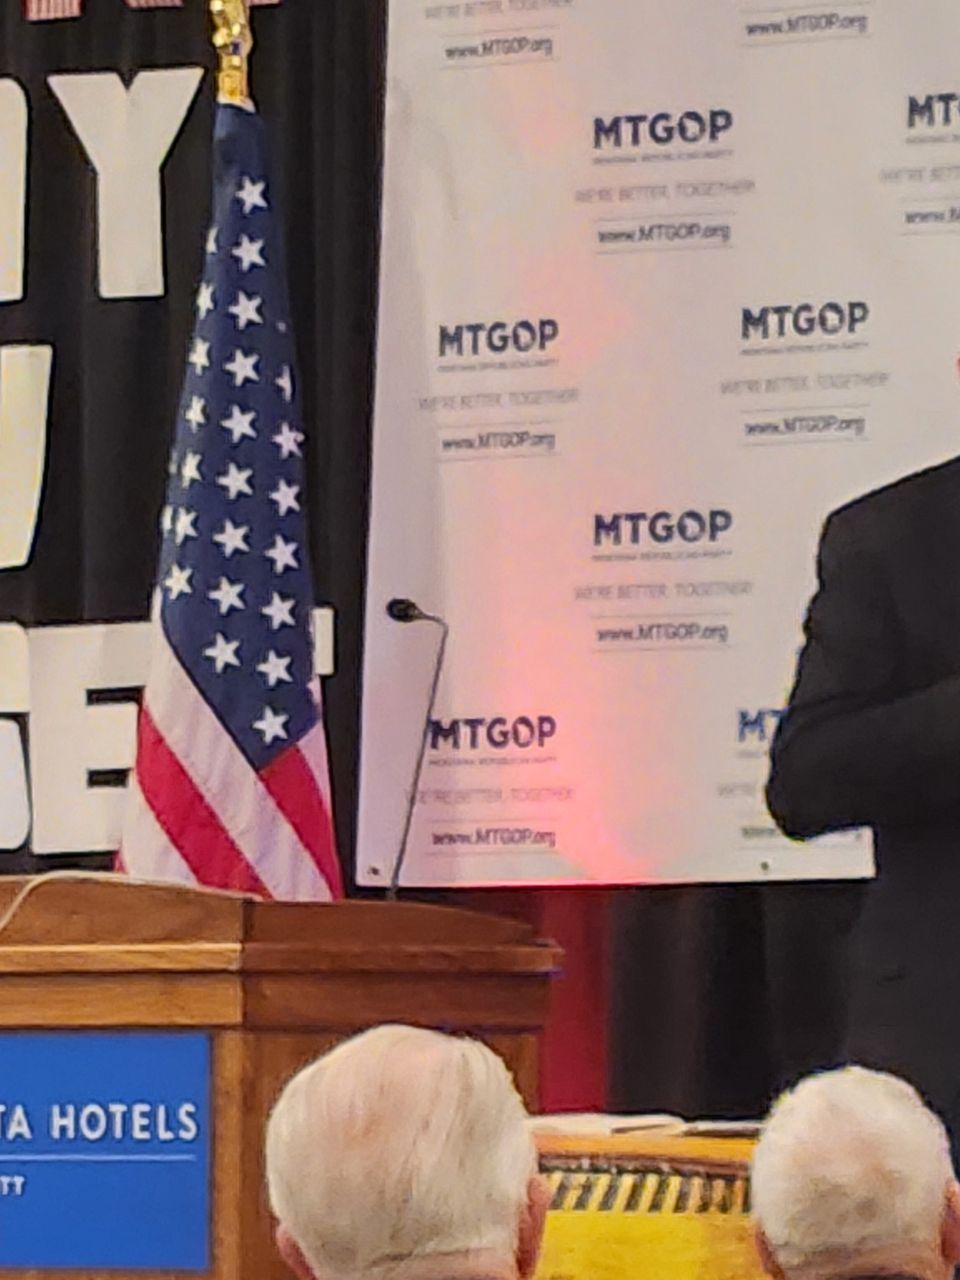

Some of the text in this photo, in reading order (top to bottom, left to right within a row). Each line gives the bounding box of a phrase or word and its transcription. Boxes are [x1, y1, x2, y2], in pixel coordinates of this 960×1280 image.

[593, 109, 733, 149] MTGOP
[598, 222, 731, 242] www.MTGOP.org
[741, 301, 869, 340] MTGOP
[438, 318, 559, 357] MTGOP
[442, 430, 556, 451] www.MTGOP.org
[744, 414, 866, 437] www.MTGOP.org
[593, 509, 733, 545] MTGOP
[597, 623, 729, 643] www.MTGOP.org
[429, 716, 556, 749] MTGOP
[432, 828, 557, 849] www.MTGOP.org
[0, 1103, 199, 1141] A HOTELS
